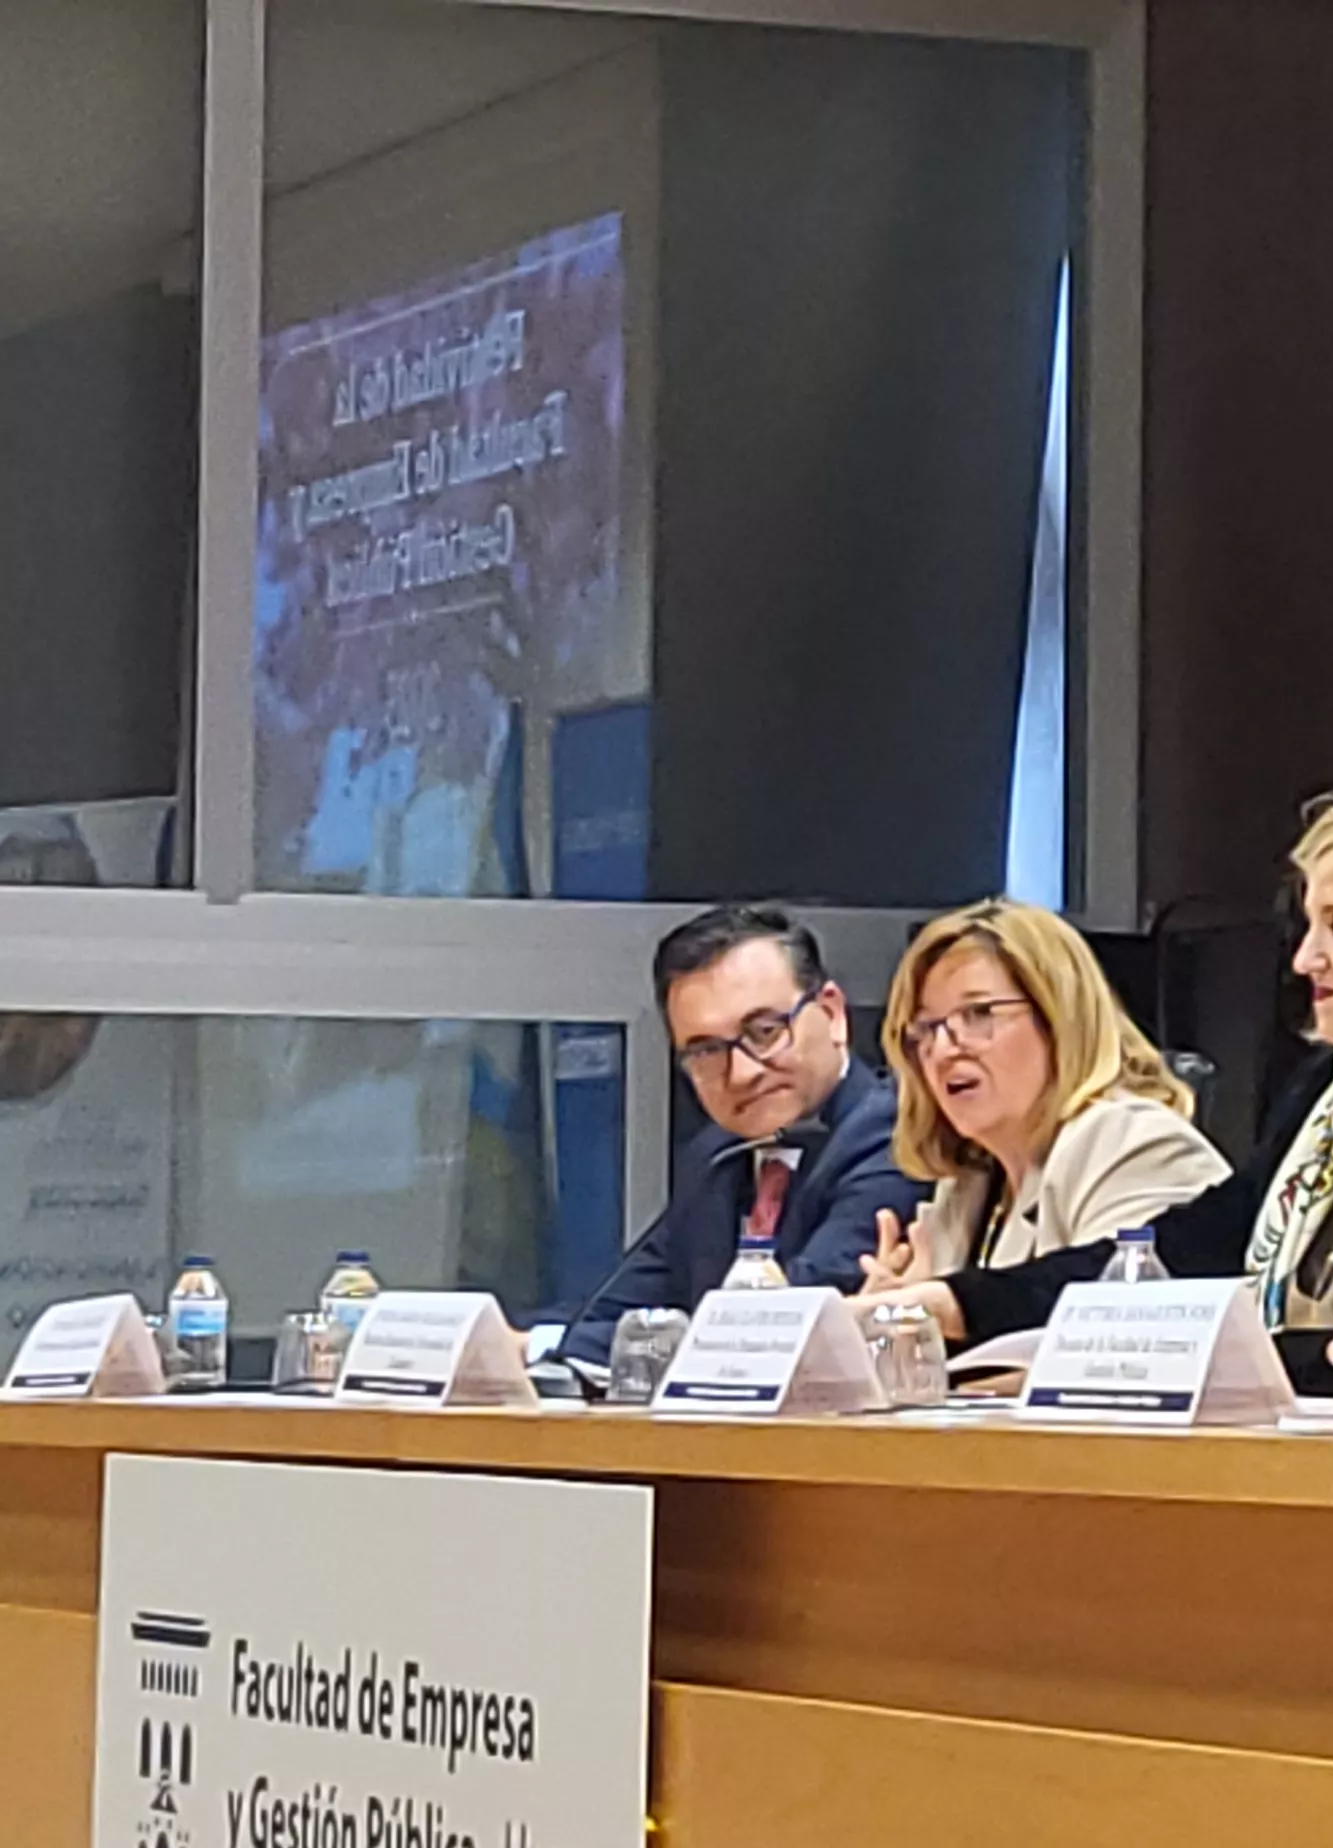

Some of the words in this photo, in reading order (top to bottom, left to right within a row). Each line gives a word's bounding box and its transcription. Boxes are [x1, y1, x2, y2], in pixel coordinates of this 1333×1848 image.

[230, 1638, 352, 1732] Facultad
[356, 1651, 395, 1740] de
[401, 1660, 536, 1775] Empresa
